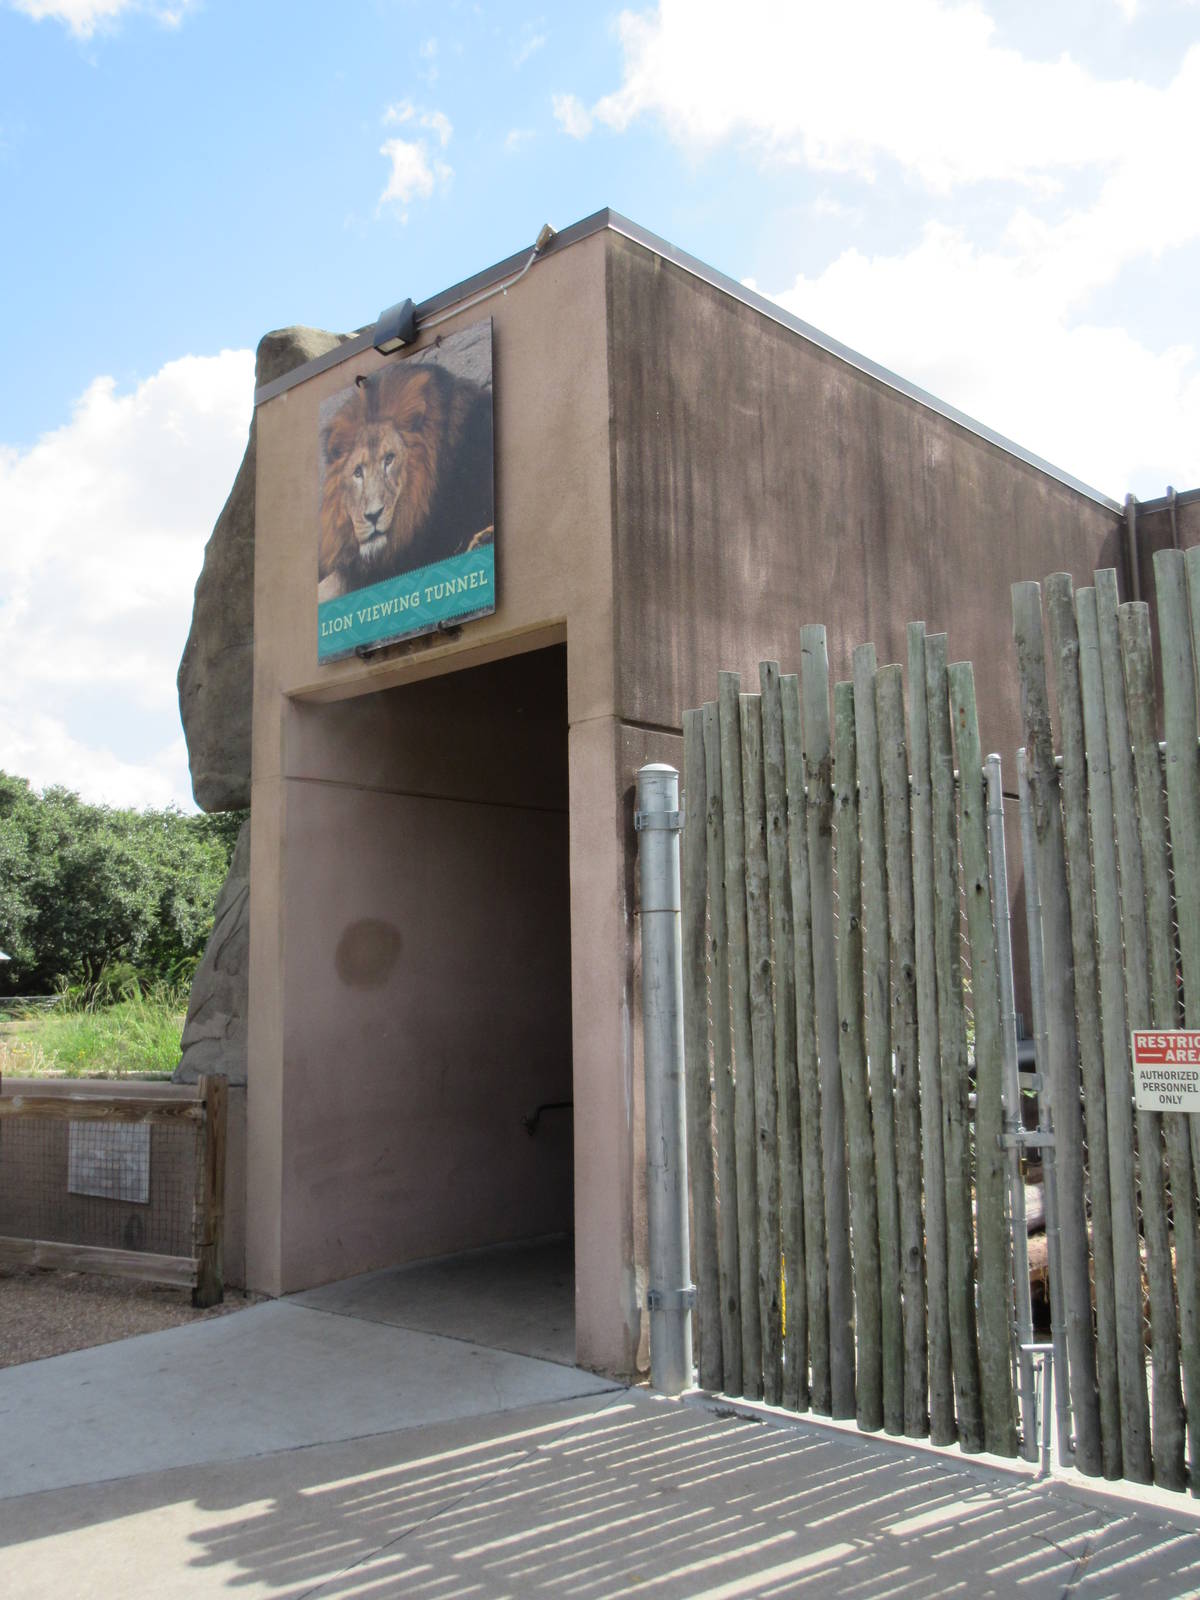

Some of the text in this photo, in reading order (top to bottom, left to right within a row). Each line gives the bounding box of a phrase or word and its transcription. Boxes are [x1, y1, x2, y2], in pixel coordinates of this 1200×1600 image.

[321, 570, 488, 636] LION VIEWING TUNNEL
[1165, 1050, 1200, 1061] ARE
[1140, 1071, 1199, 1080] AUTHORIZED
[1143, 1083, 1199, 1093] PERSONNEL
[1159, 1095, 1182, 1105] ONLY
